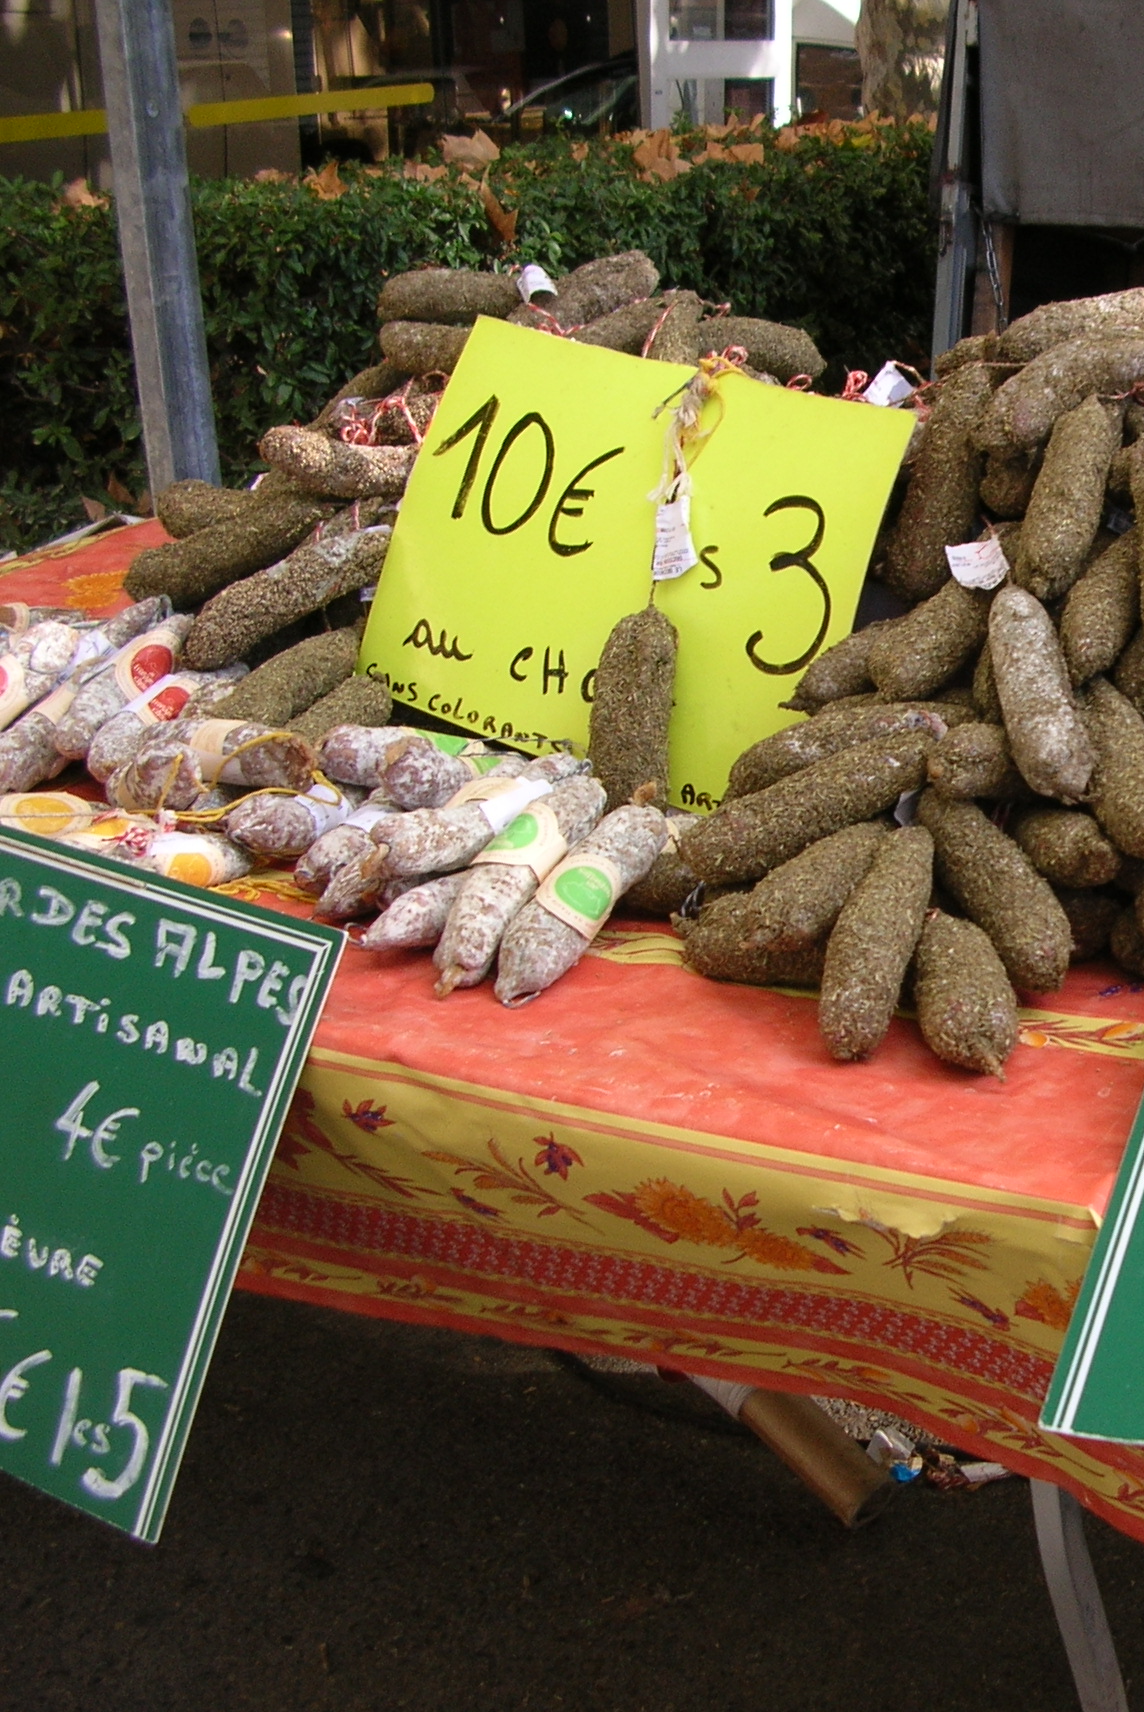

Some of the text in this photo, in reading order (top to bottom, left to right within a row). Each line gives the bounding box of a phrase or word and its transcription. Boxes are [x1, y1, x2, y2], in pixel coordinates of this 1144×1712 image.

[433, 394, 625, 557] 10€
[402, 618, 474, 662] au
[746, 494, 832, 676] 3
[31, 885, 137, 959] DES
[154, 917, 309, 1026] ALPES
[55, 1080, 141, 1168] 4€
